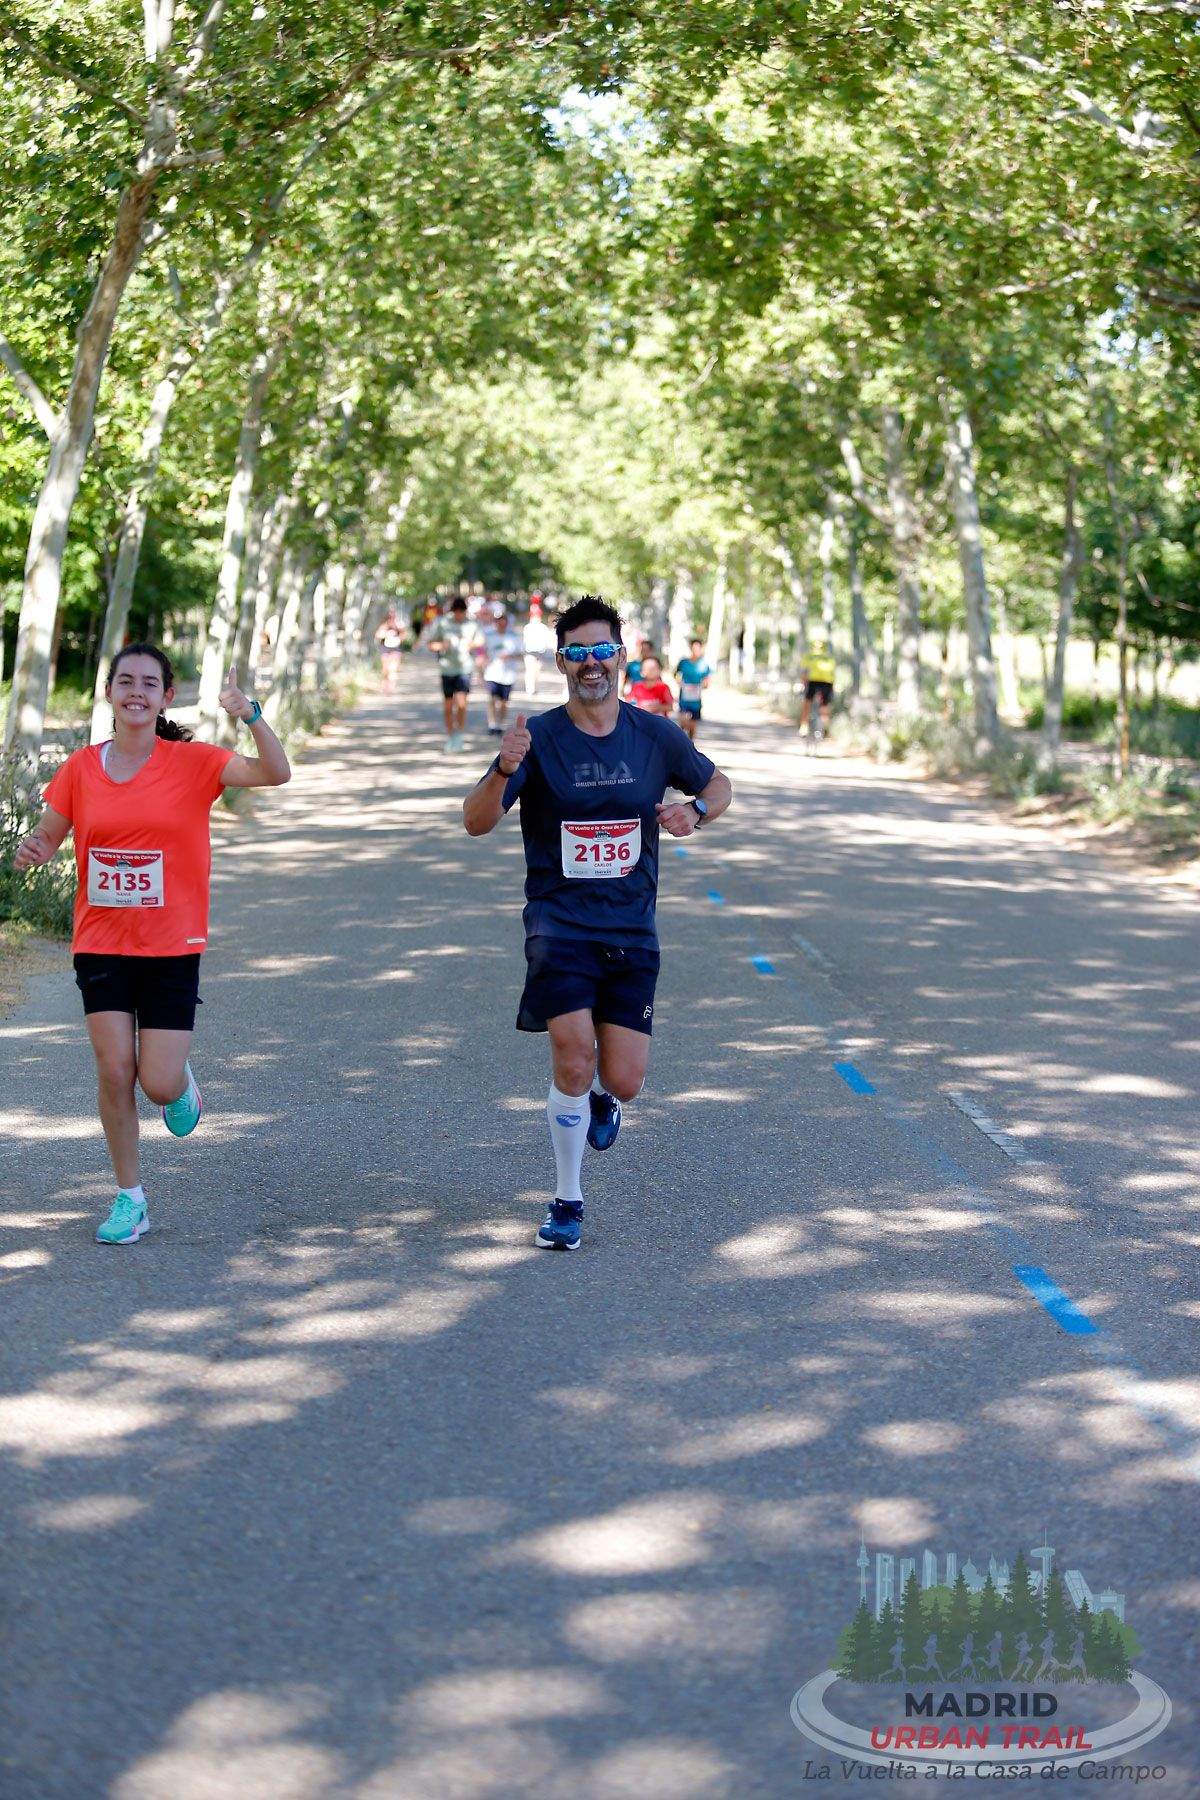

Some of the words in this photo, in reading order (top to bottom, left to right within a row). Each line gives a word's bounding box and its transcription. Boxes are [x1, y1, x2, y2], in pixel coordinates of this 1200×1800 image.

[574, 761, 631, 780] FILA
[574, 842, 631, 862] 2136
[98, 871, 151, 891] 2135
